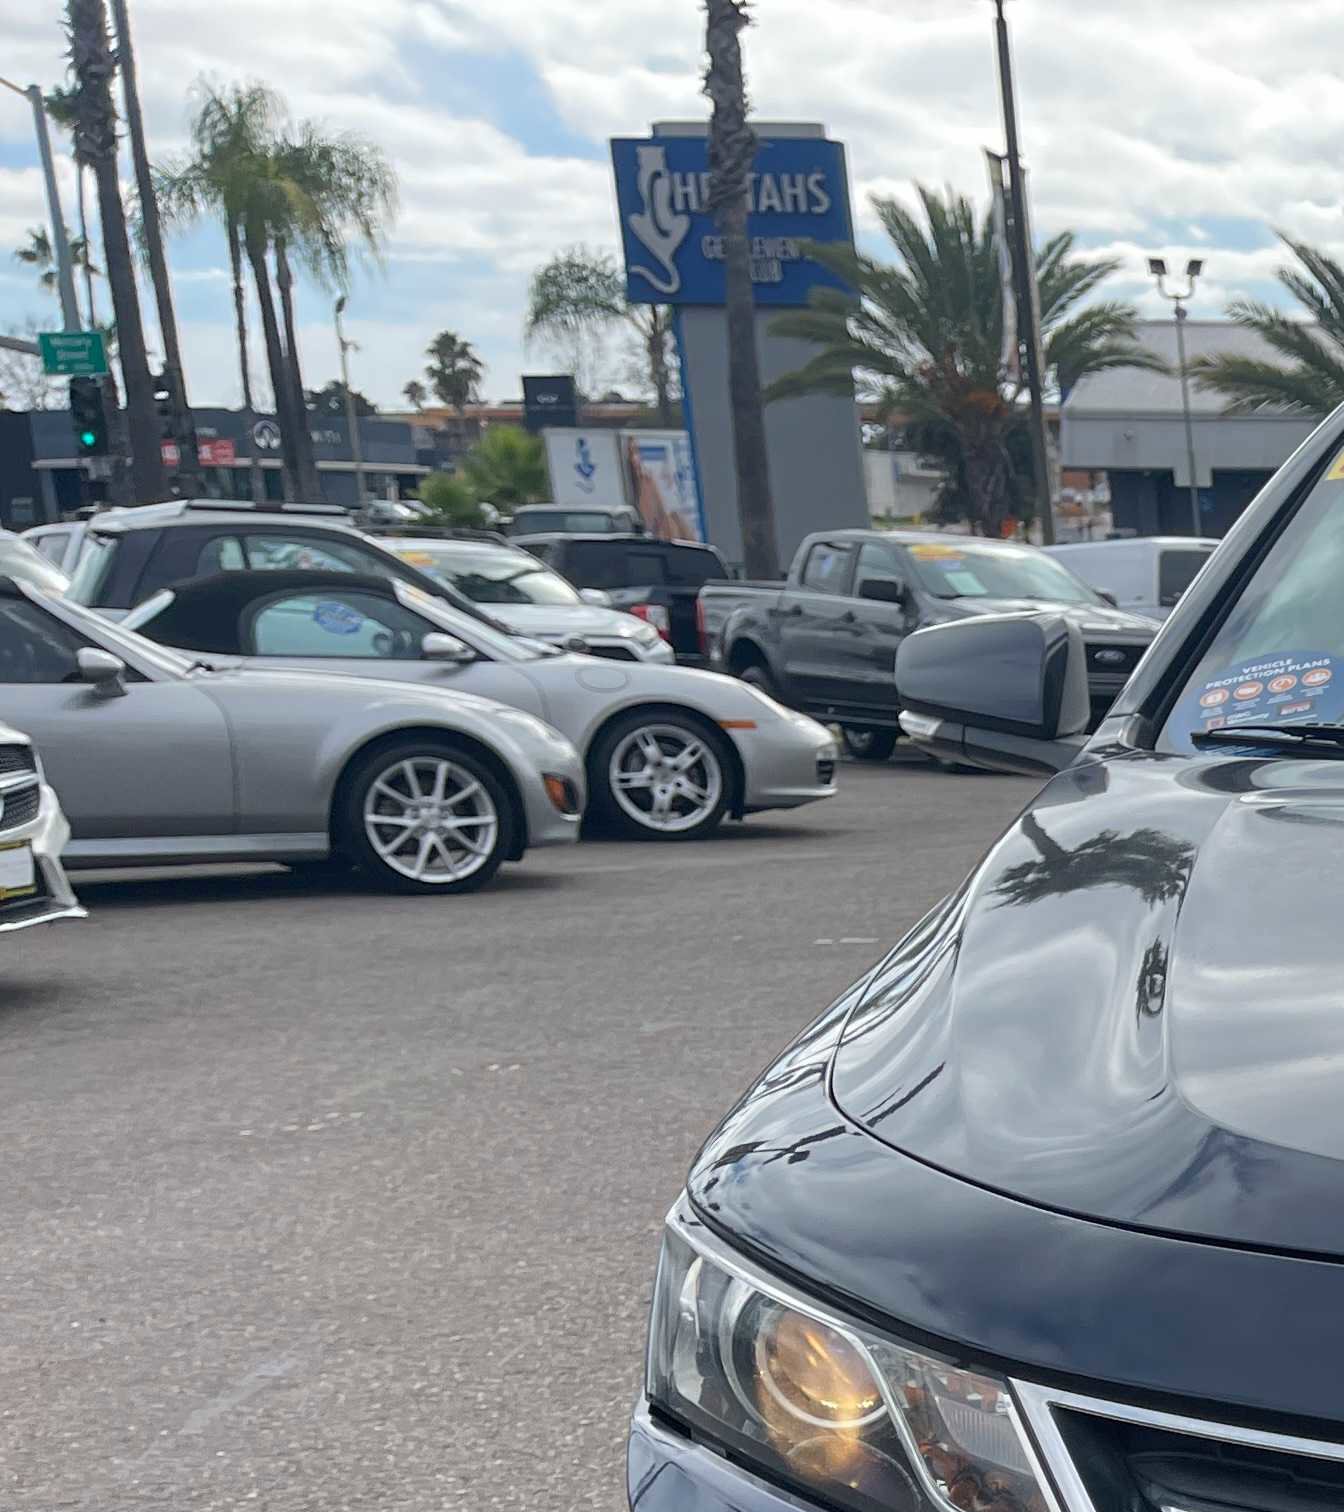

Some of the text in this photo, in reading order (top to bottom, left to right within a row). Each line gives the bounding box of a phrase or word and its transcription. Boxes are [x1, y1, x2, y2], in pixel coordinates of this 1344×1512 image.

[1205, 657, 1331, 690] PROTECTION PLANS
[1241, 657, 1293, 675] VEHICLE
